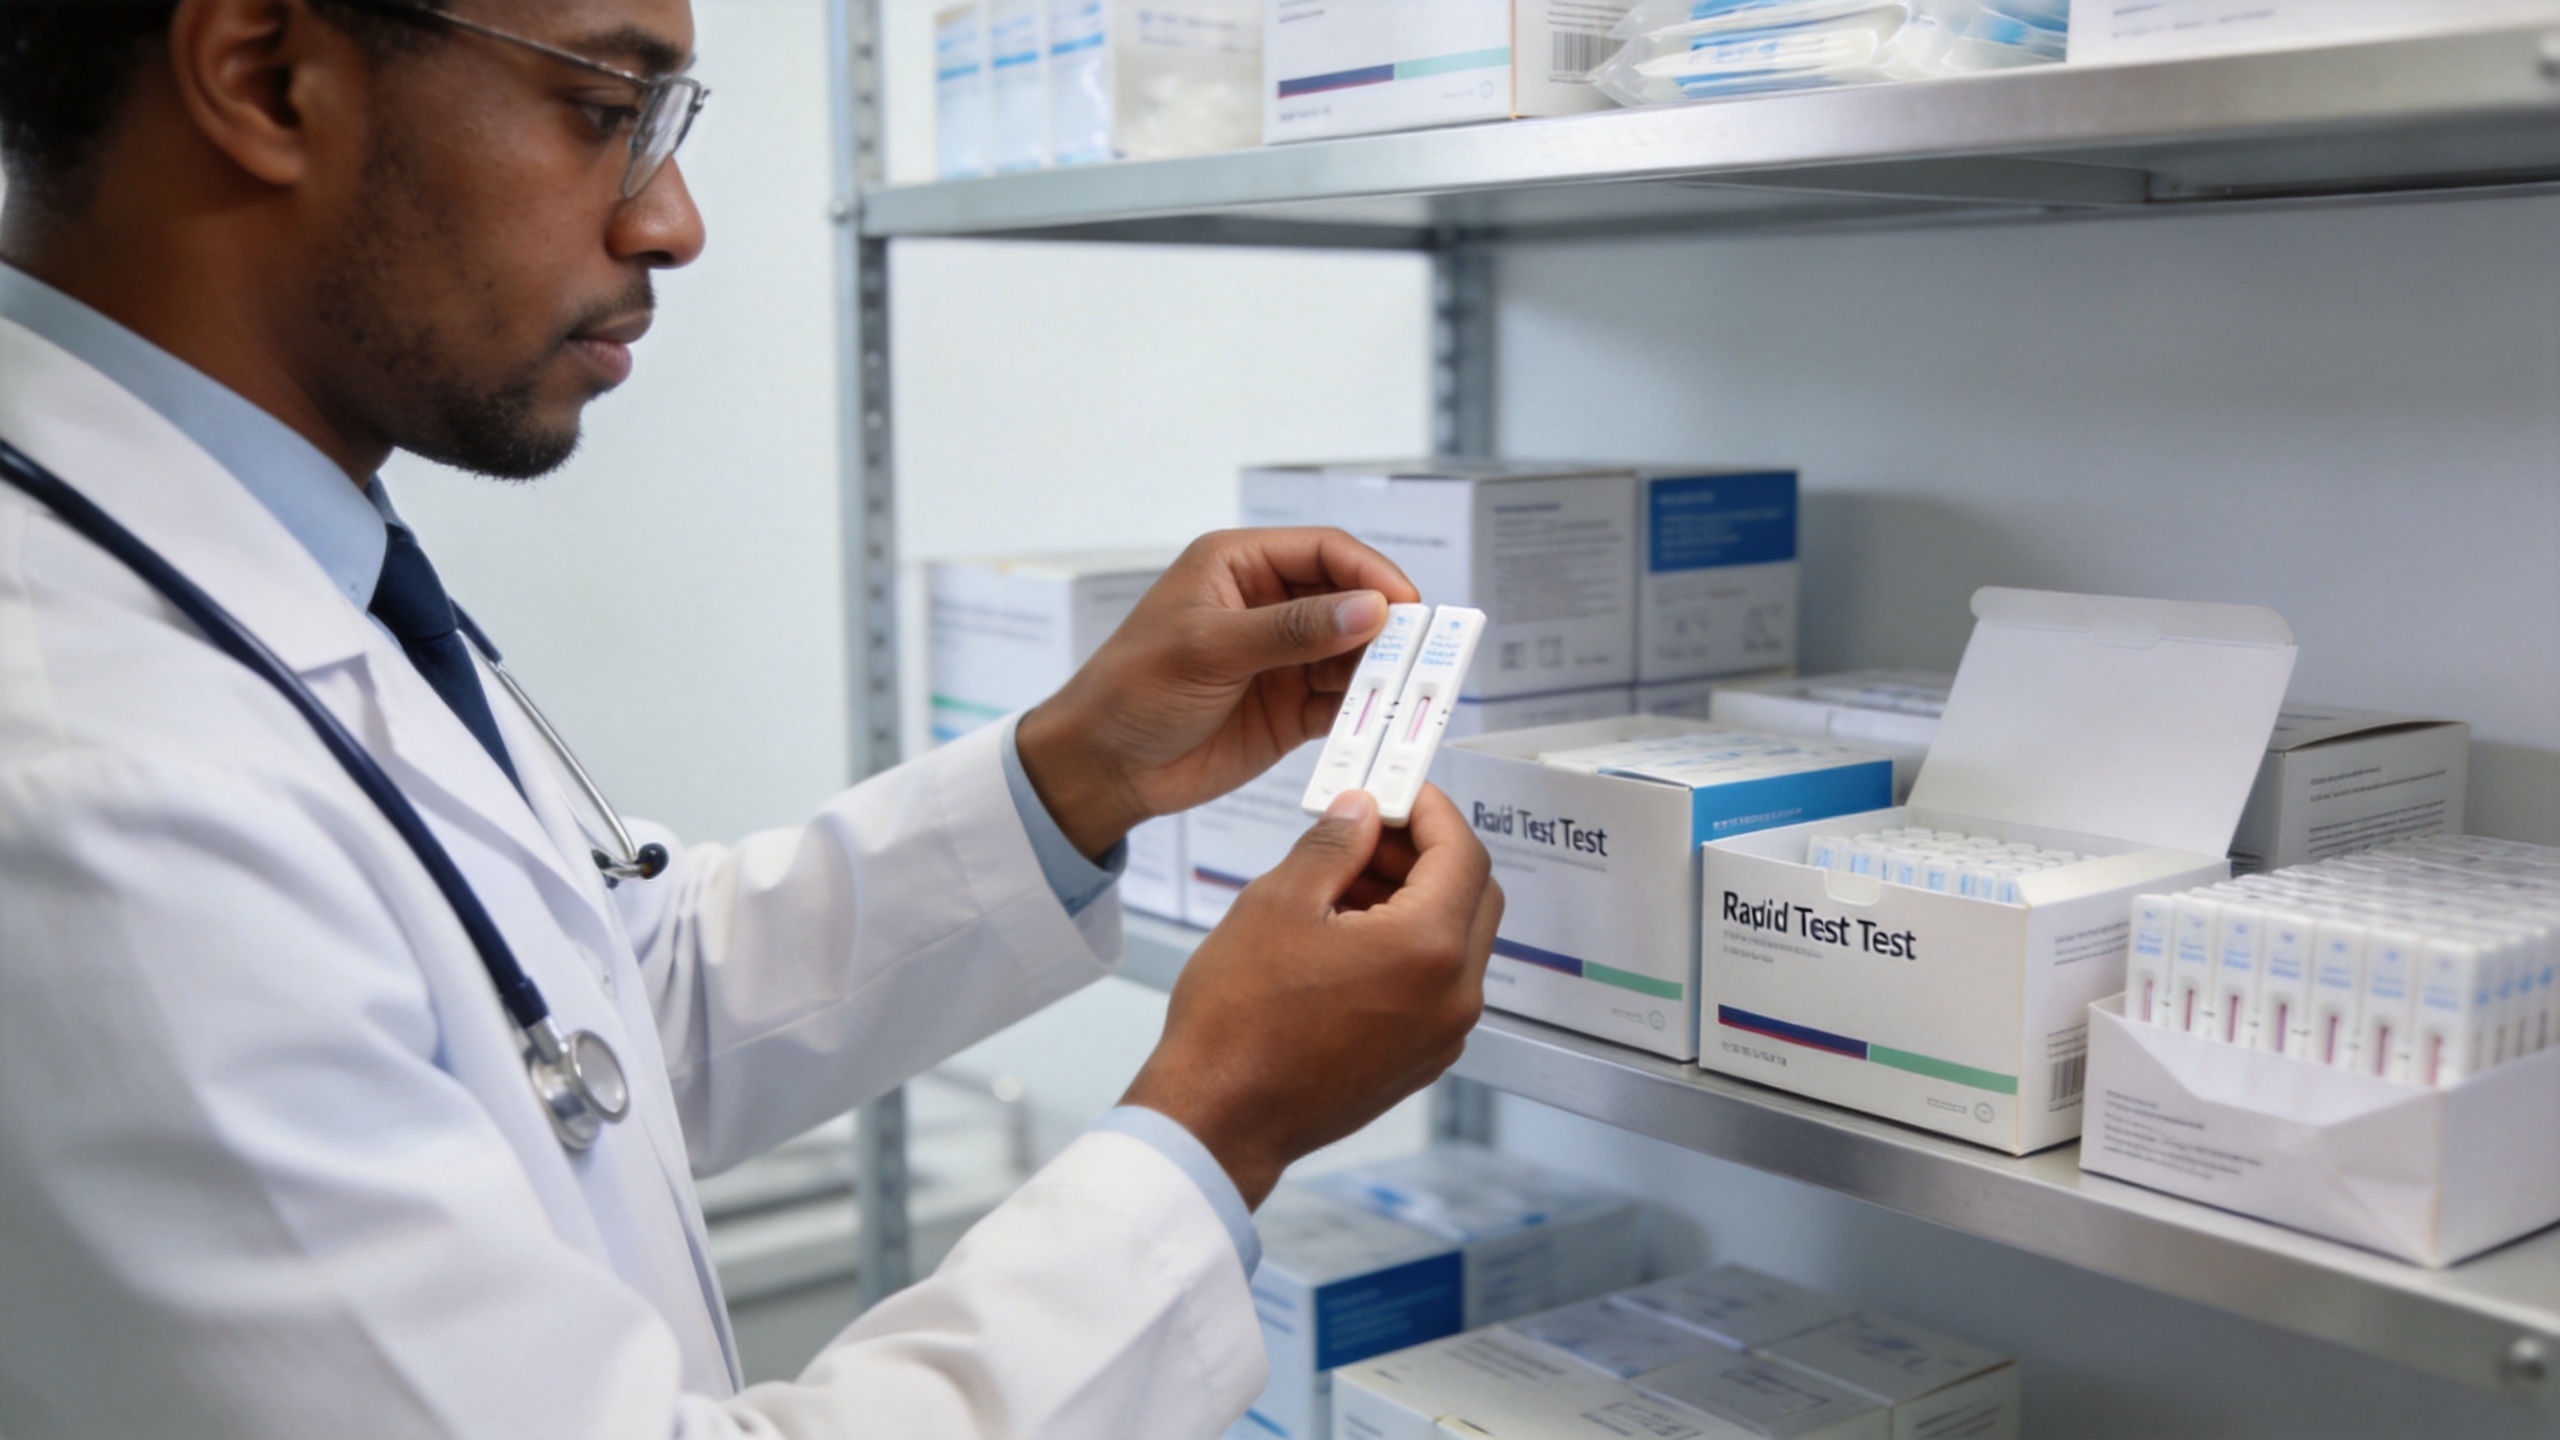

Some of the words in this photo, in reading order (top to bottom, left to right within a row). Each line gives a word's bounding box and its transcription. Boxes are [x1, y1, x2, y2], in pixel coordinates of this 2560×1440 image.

[1559, 817, 1607, 857] Test
[1723, 890, 1789, 934] Rapid
[1793, 905, 1851, 947] Test
[1856, 919, 1917, 961] Test
